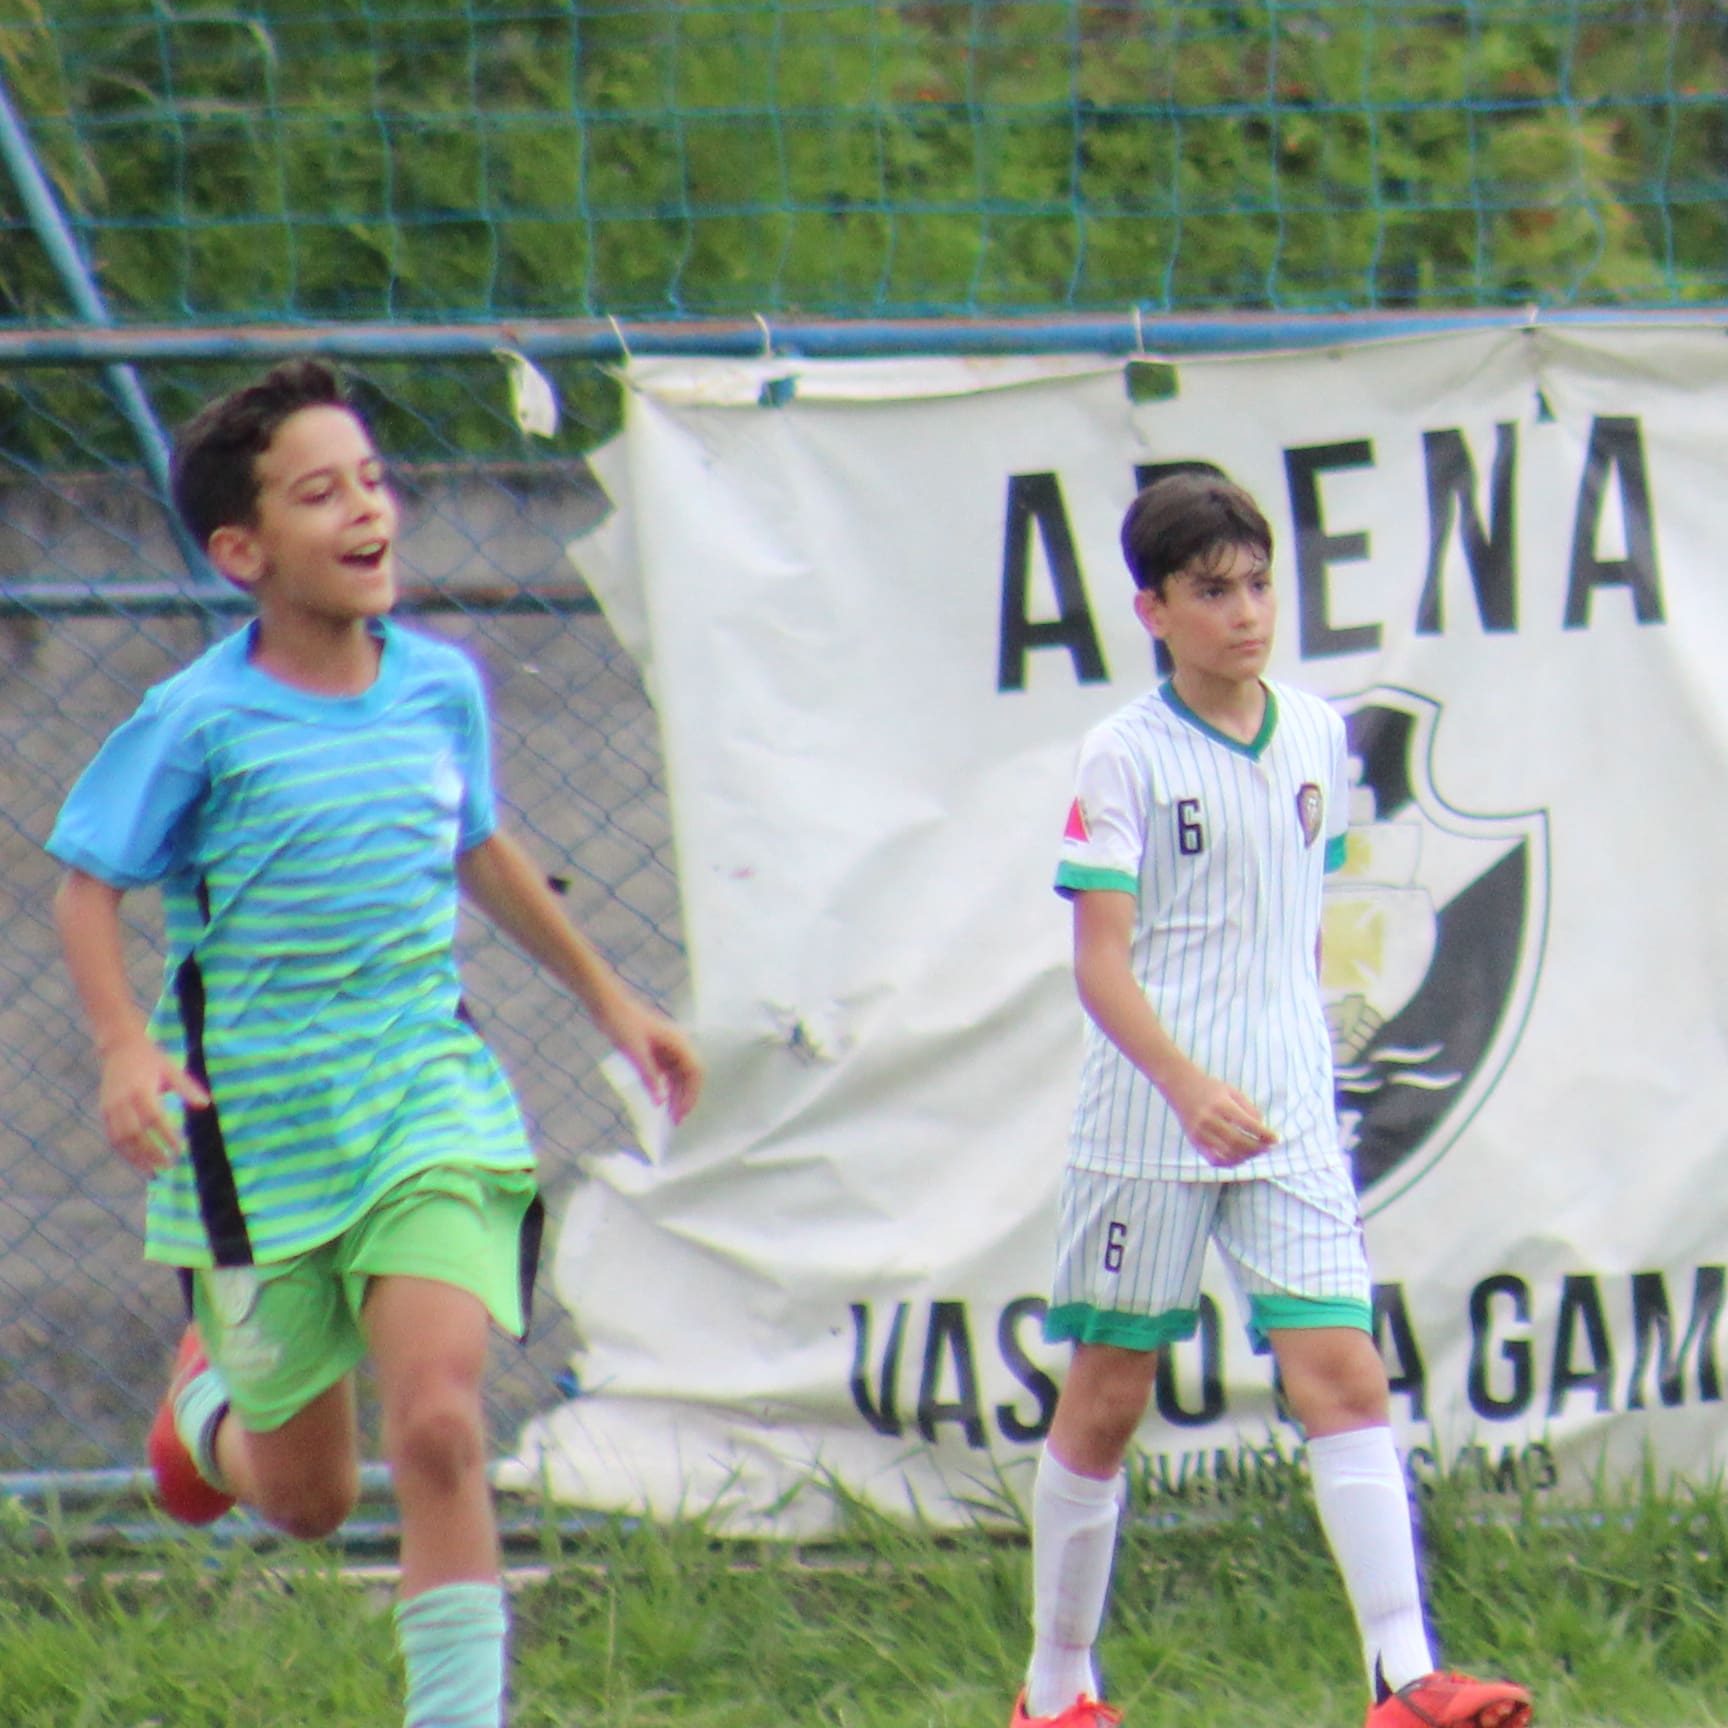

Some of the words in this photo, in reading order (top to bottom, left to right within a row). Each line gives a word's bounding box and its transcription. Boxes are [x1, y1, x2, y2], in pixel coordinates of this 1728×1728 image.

[997, 414, 1666, 693] AENA
[1176, 797, 1203, 856] 6
[1103, 1220, 1128, 1274] 6
[849, 1291, 1226, 1449] VASO
[1272, 1282, 1428, 1424] A
